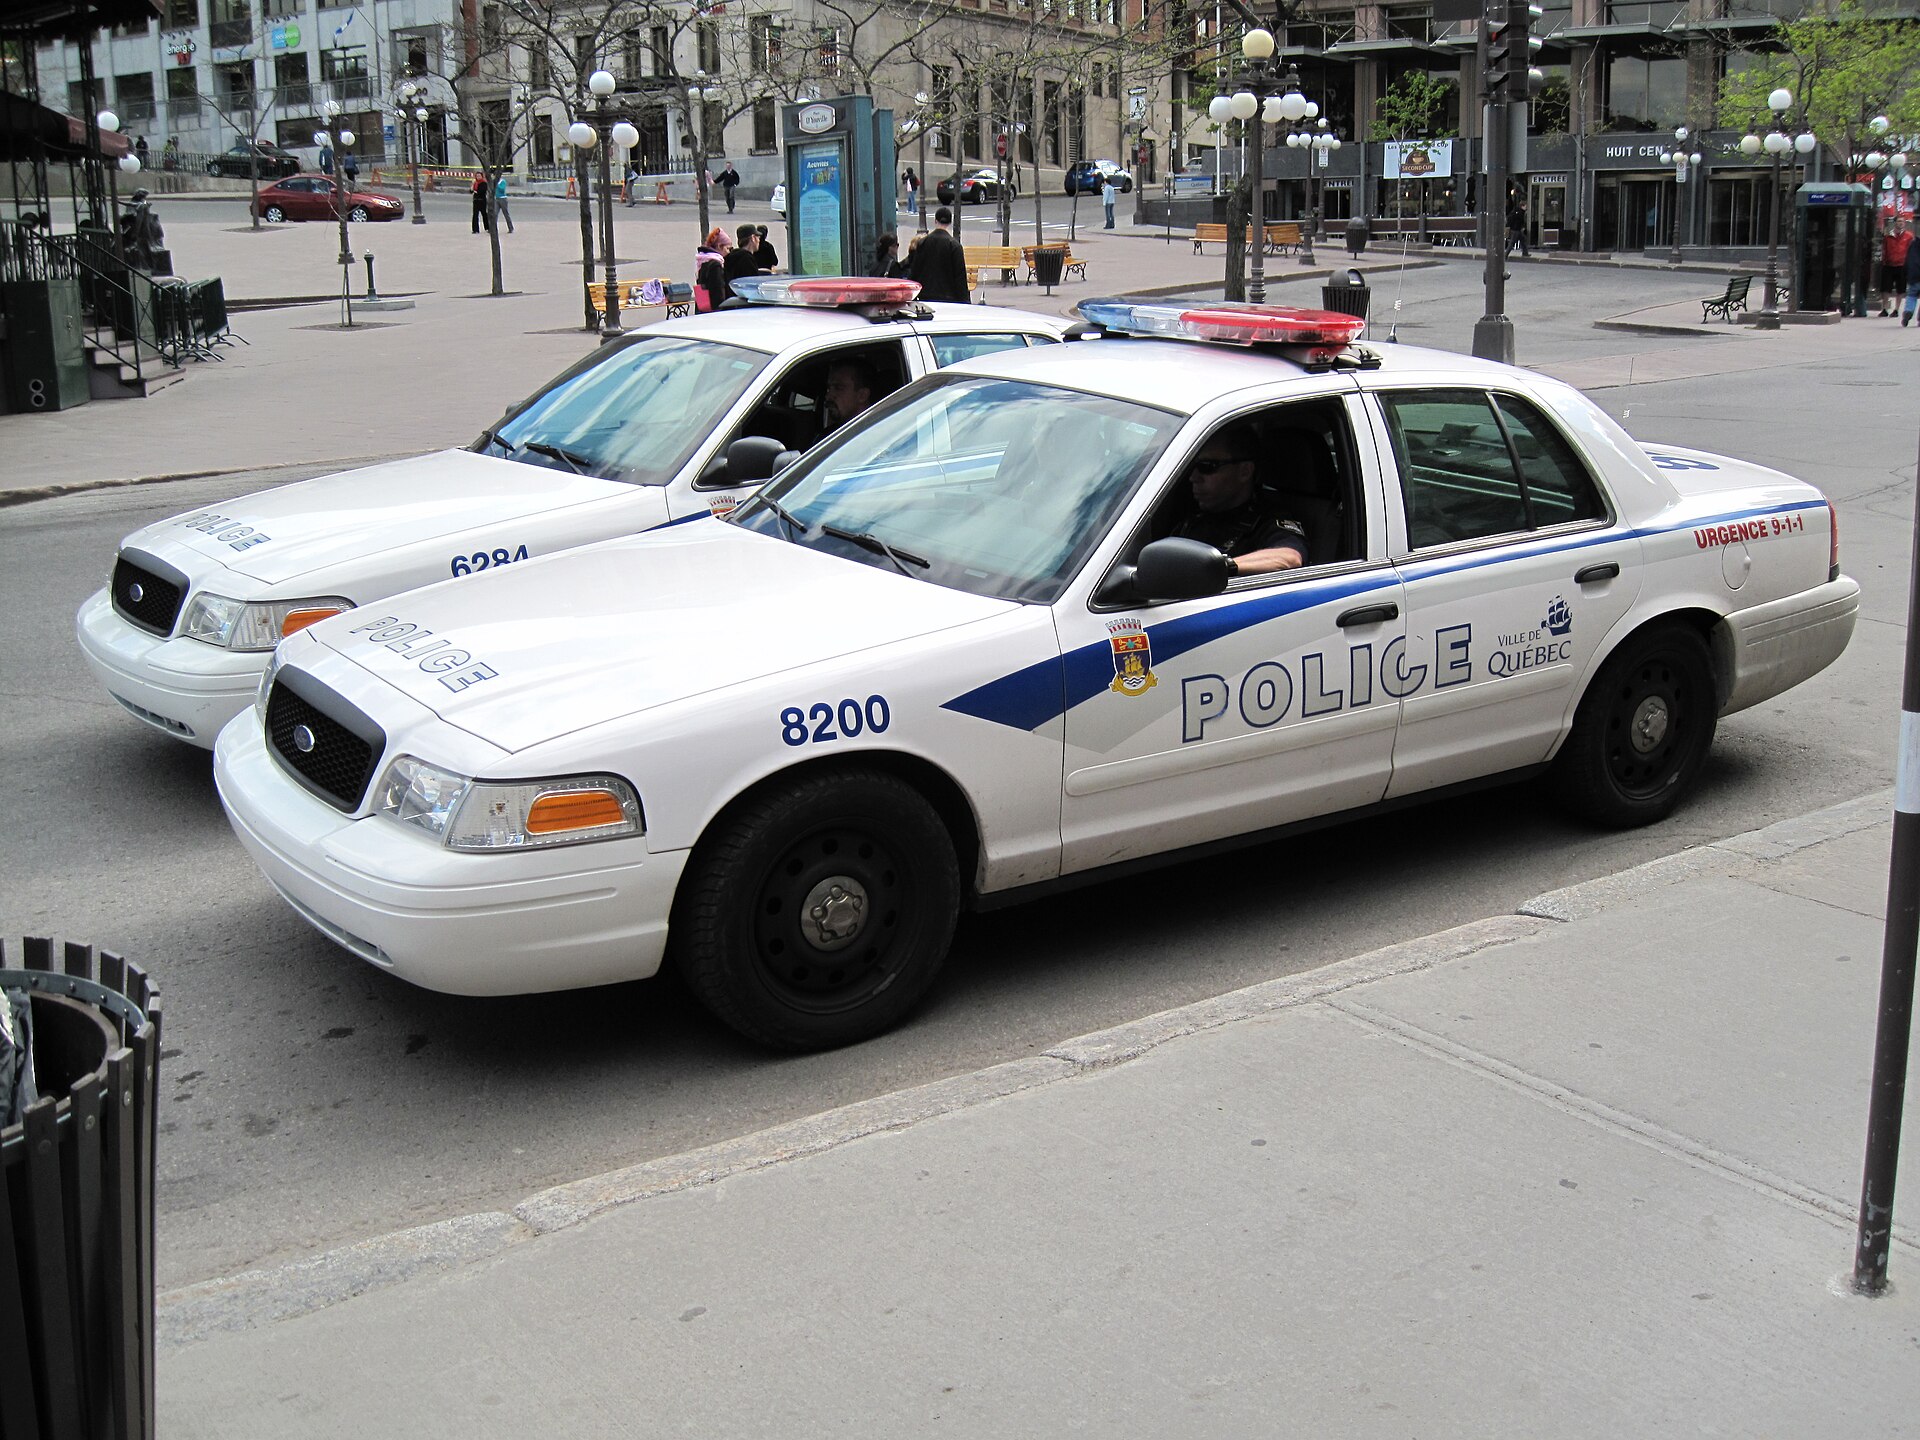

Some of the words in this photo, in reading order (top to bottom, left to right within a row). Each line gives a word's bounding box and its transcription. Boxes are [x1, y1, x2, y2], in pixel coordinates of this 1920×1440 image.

[1606, 146, 1633, 157] HUIT
[1639, 144, 1671, 157] CEN
[173, 513, 272, 552] POLICE
[1694, 520, 1768, 549] URGENCE
[1771, 514, 1804, 536] 9-1-1
[349, 616, 500, 693] POLICE
[1488, 640, 1572, 678] QUÉBEC
[1181, 623, 1472, 743] POLICE
[780, 694, 890, 747] 8200
